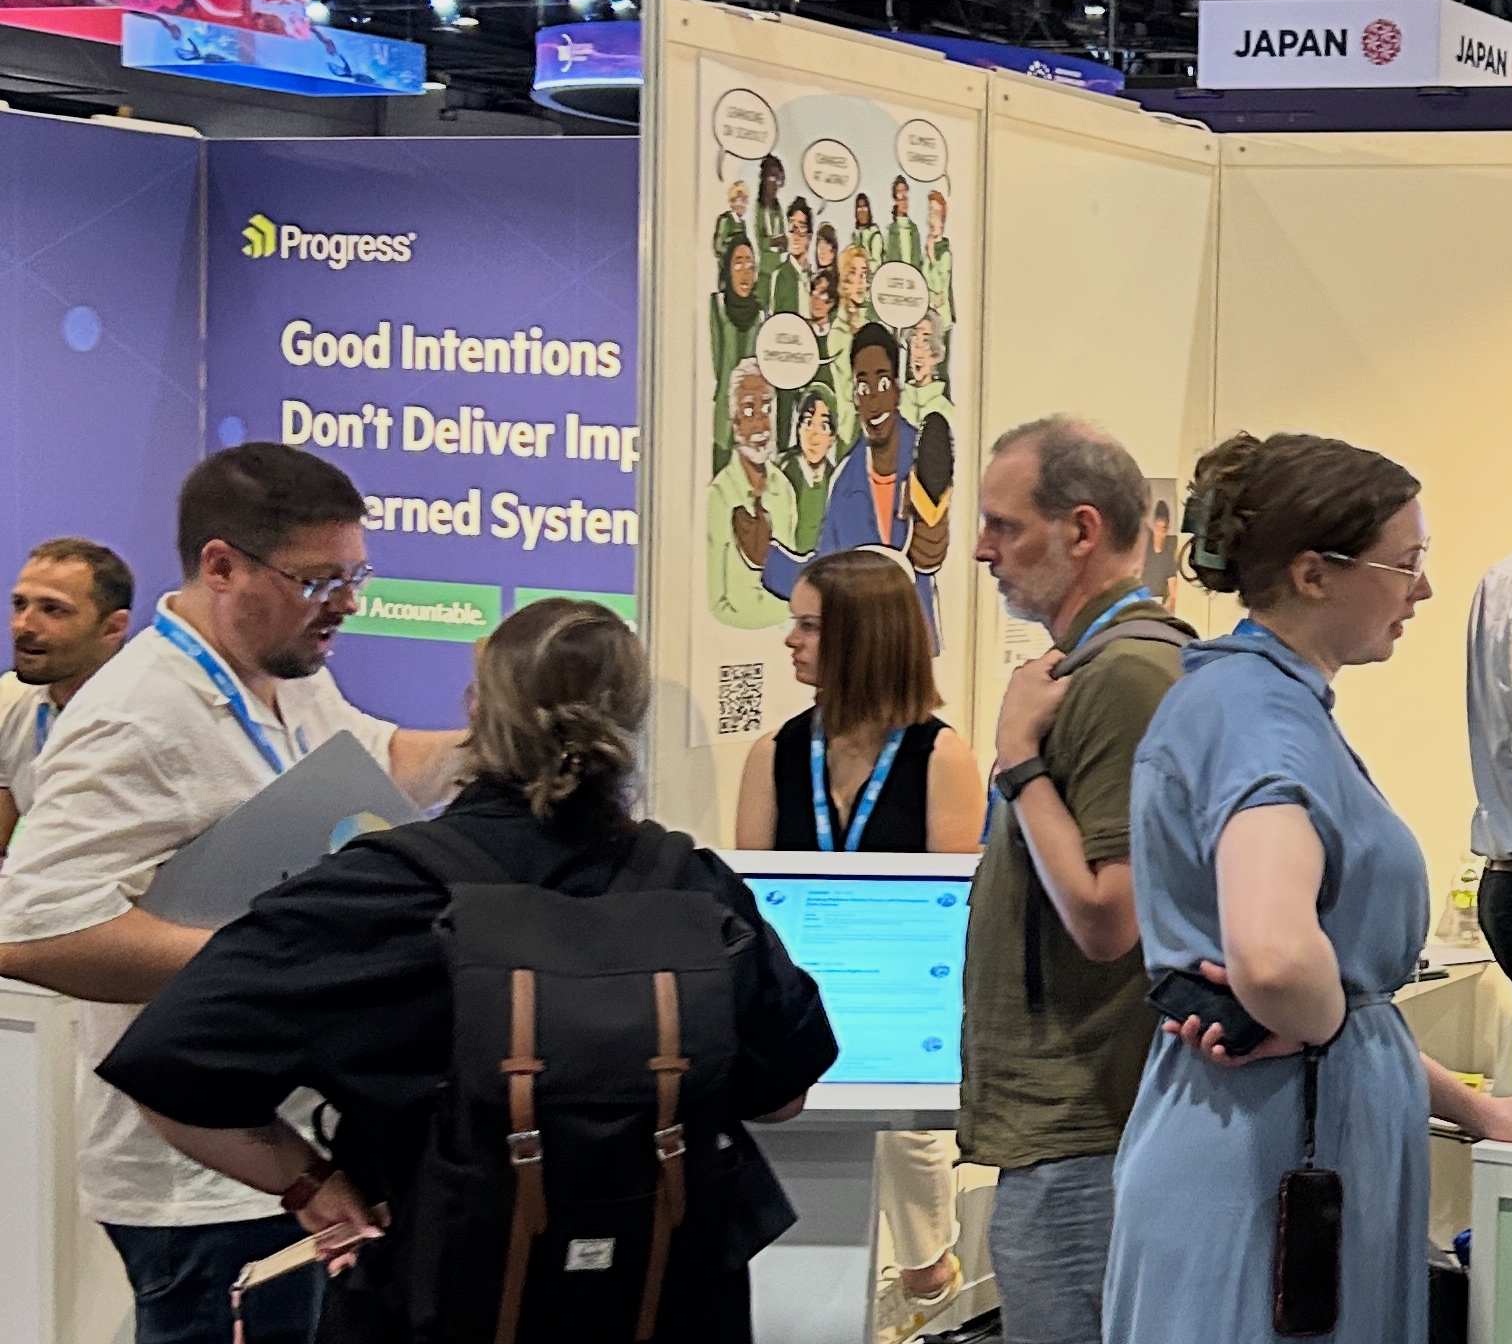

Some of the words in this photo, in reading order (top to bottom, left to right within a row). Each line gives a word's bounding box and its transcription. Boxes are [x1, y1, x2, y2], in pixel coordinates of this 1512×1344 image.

[1233, 29, 1348, 57] JAPAN
[1456, 35, 1508, 78] JAPAN
[280, 225, 417, 270] Progress
[281, 320, 391, 369] Good
[402, 325, 622, 378] Intentions
[281, 400, 393, 449] Don't
[402, 405, 555, 458] Deliver
